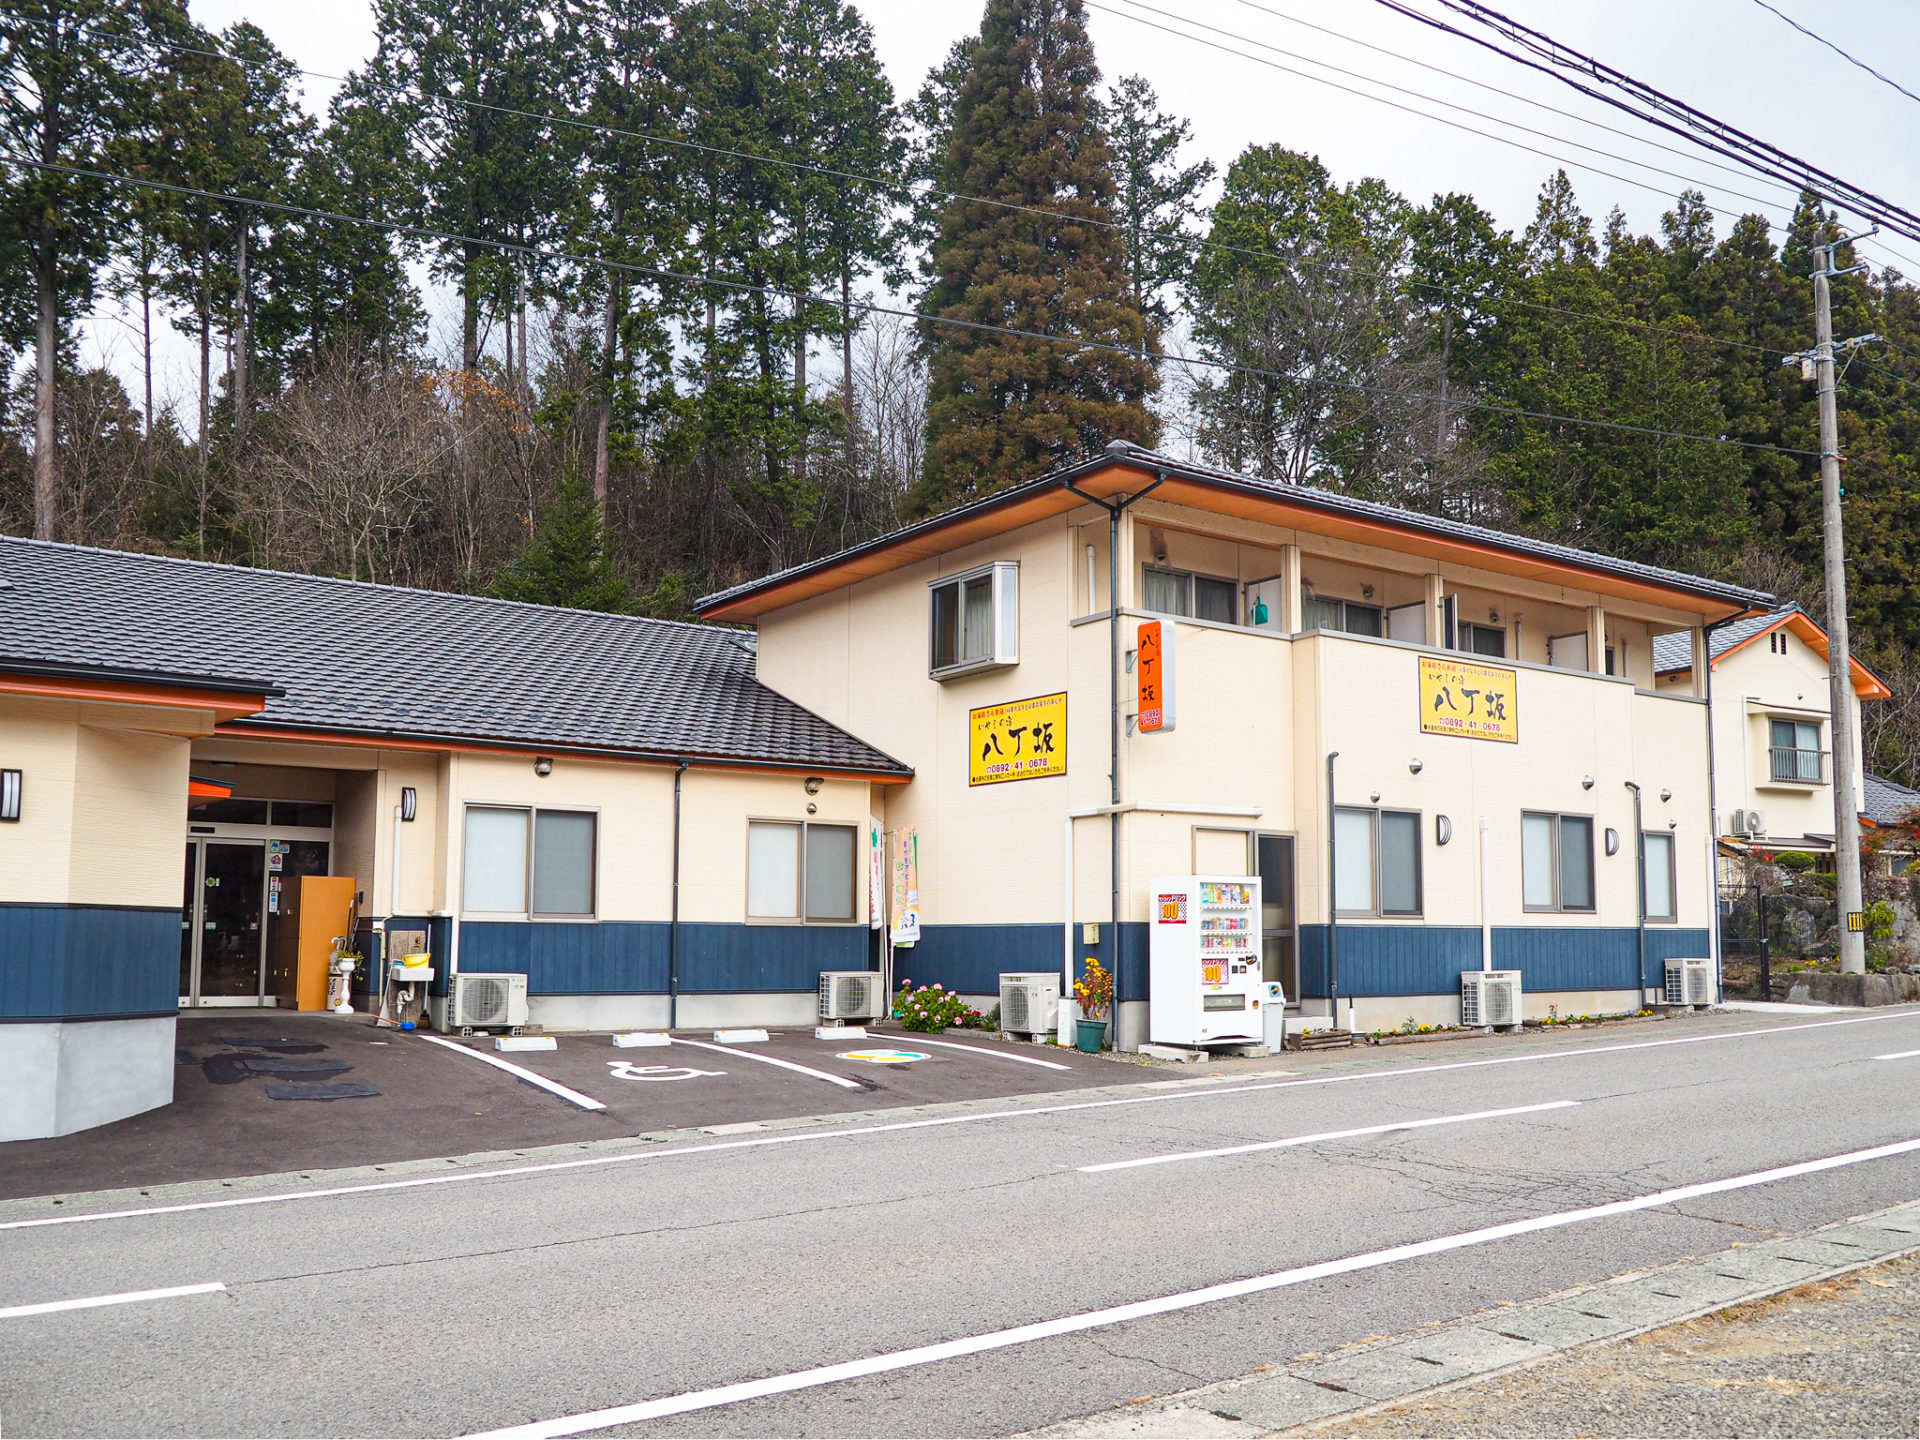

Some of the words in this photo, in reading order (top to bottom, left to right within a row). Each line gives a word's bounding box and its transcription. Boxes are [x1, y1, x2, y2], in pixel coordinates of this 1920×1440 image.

[1141, 634, 1155, 701] 八丁坂
[1434, 686, 1507, 721] 八丁坂
[982, 722, 1055, 761] 八丁坂
